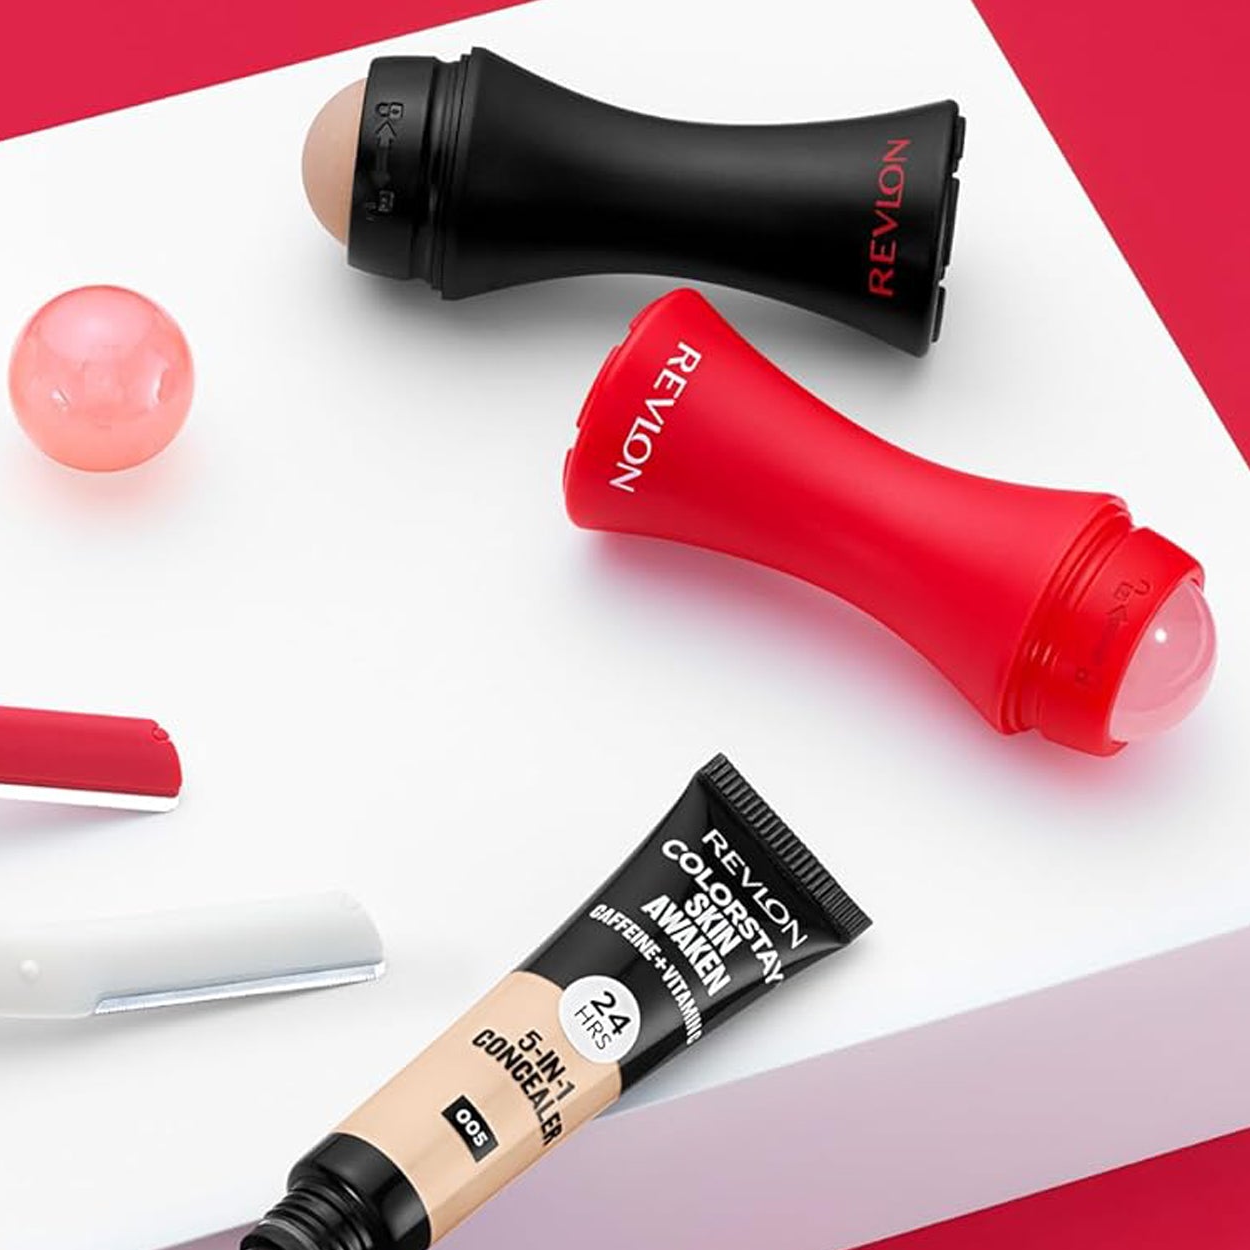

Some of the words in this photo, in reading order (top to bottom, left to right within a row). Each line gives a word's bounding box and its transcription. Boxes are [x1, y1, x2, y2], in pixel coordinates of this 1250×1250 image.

[869, 138, 911, 296] REVLON
[609, 341, 701, 492] REVLON
[662, 839, 784, 985] COLORSTAY
[684, 892, 742, 957] SKIN
[702, 829, 808, 949] REVLON
[642, 895, 731, 997] AWAKEN
[574, 1005, 612, 1050] HRS
[591, 990, 631, 1035] 24
[471, 1029, 563, 1146] CONCEALER
[517, 1029, 576, 1101] 5-IN-1
[455, 1109, 488, 1147] 005
